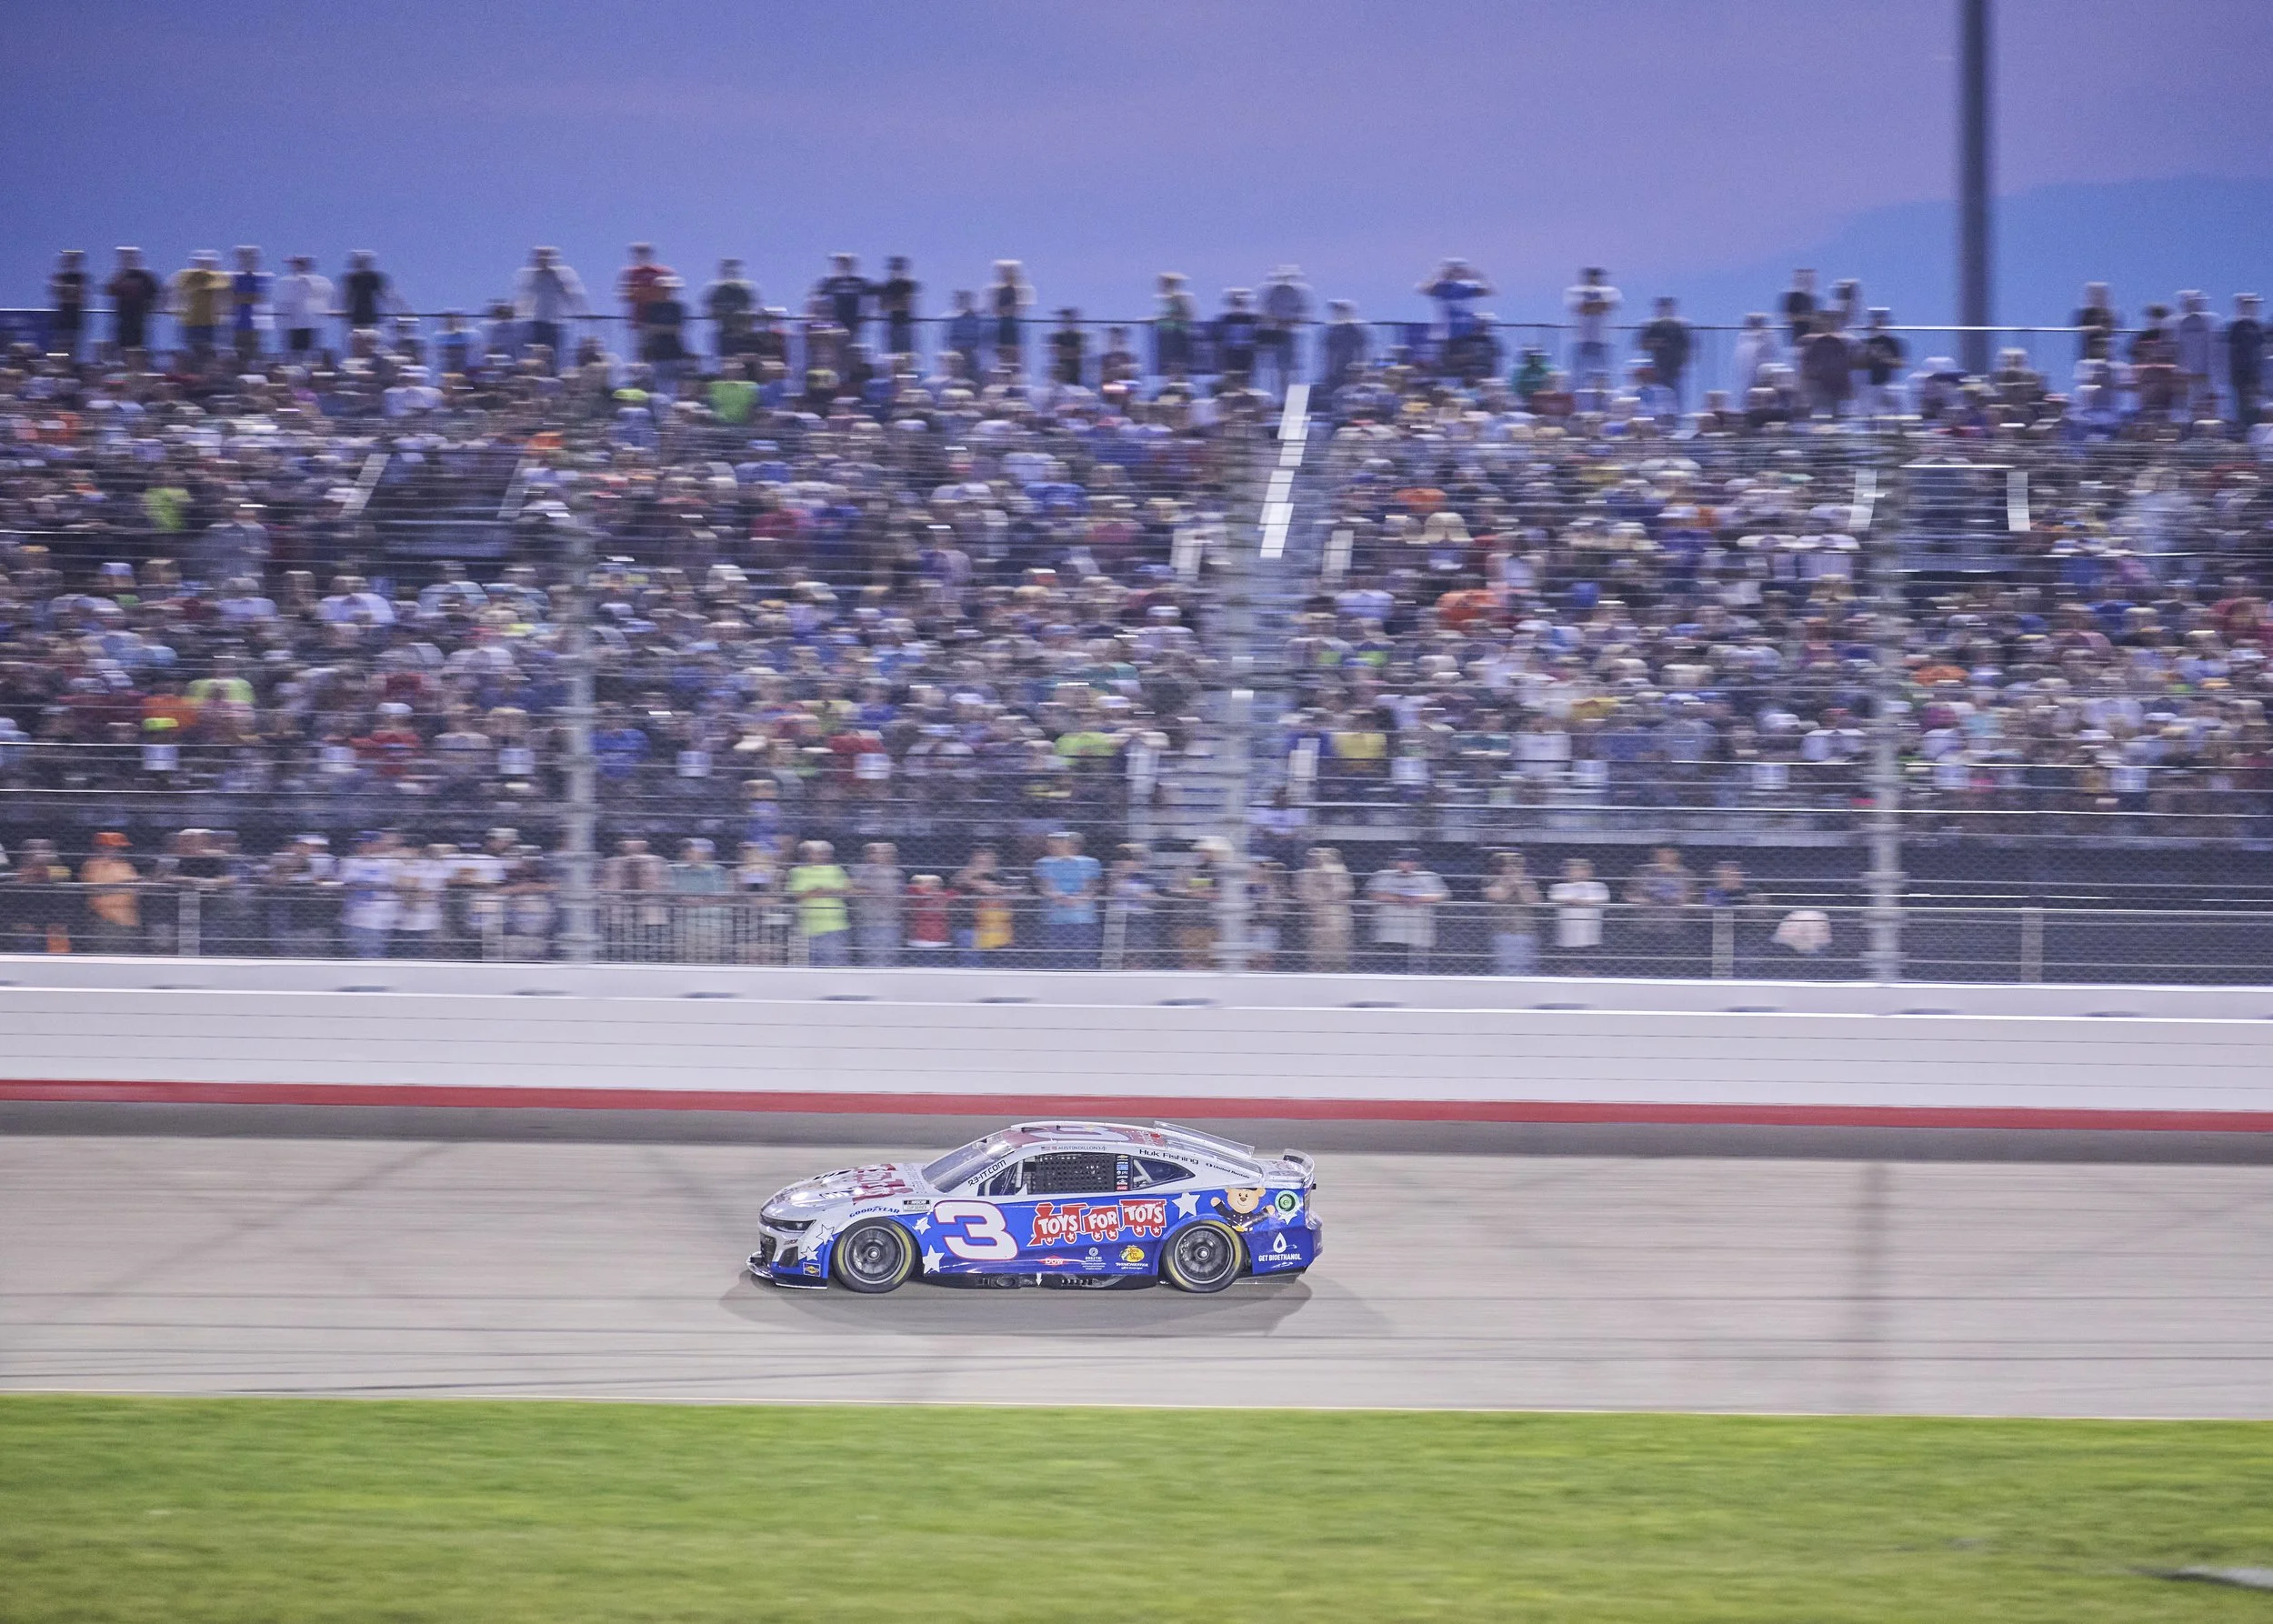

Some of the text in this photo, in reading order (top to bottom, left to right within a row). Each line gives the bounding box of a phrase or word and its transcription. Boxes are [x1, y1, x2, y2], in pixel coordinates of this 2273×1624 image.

[1139, 1148, 1199, 1165] Huk Fishing
[849, 1206, 900, 1218] GOODYEAR
[1038, 1203, 1164, 1235] TOYS FOR TOTS
[933, 1199, 1018, 1261] 3
